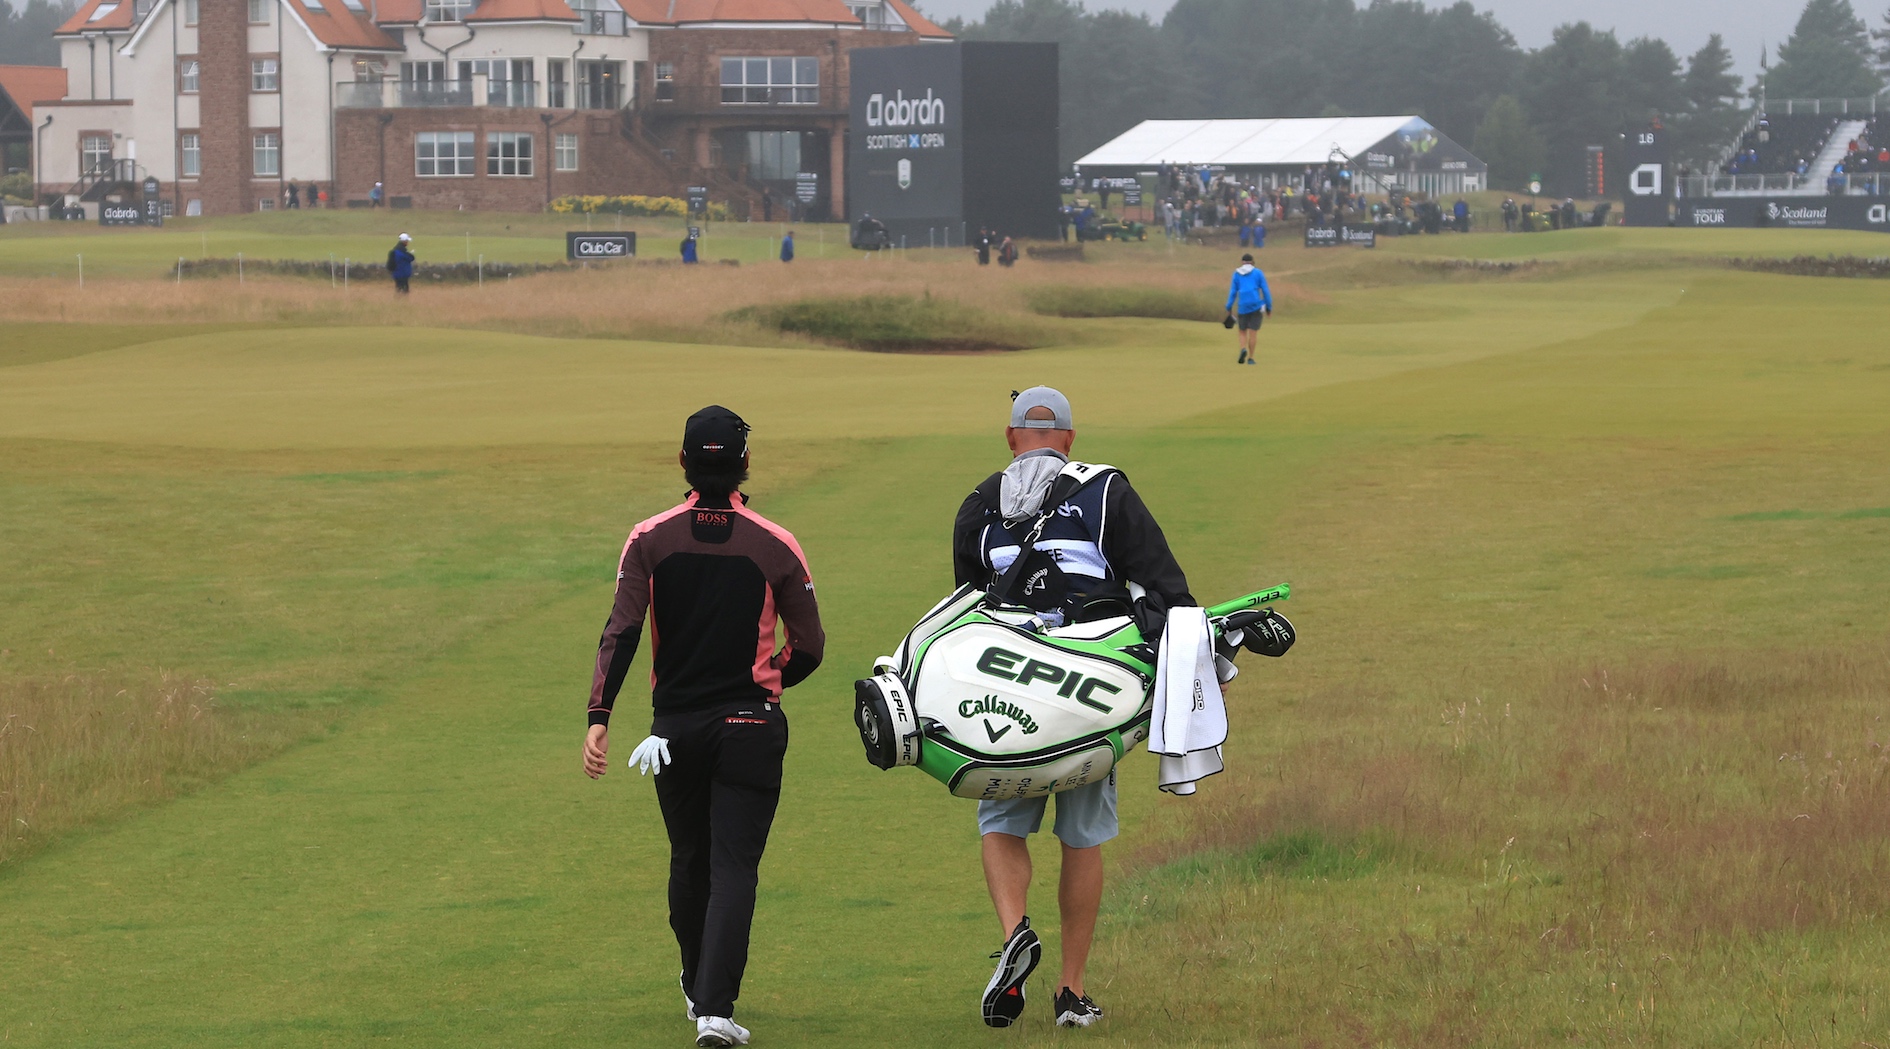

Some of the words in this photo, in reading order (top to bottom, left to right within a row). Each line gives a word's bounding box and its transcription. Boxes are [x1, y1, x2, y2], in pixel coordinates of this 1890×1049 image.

[884, 87, 945, 126] abrdn
[867, 135, 908, 149] SCOTTISH
[921, 133, 945, 149] OPEN
[1638, 132, 1655, 144] 18
[112, 206, 138, 218] abrdn
[1694, 213, 1725, 224] TOUR
[1782, 206, 1828, 219] Scotland
[1315, 226, 1337, 239] abrdn
[1349, 229, 1374, 240] Scotland
[580, 241, 604, 254] Club
[604, 241, 622, 254] Car
[697, 512, 728, 524] BOSS
[1024, 567, 1049, 596] Callaway
[1248, 591, 1280, 607] EPIC
[976, 646, 1122, 715] EPIC
[1193, 678, 1205, 711] OGIO
[890, 690, 908, 723] EPIC
[958, 694, 1040, 735] Callaway
[902, 734, 912, 761] EPIC
